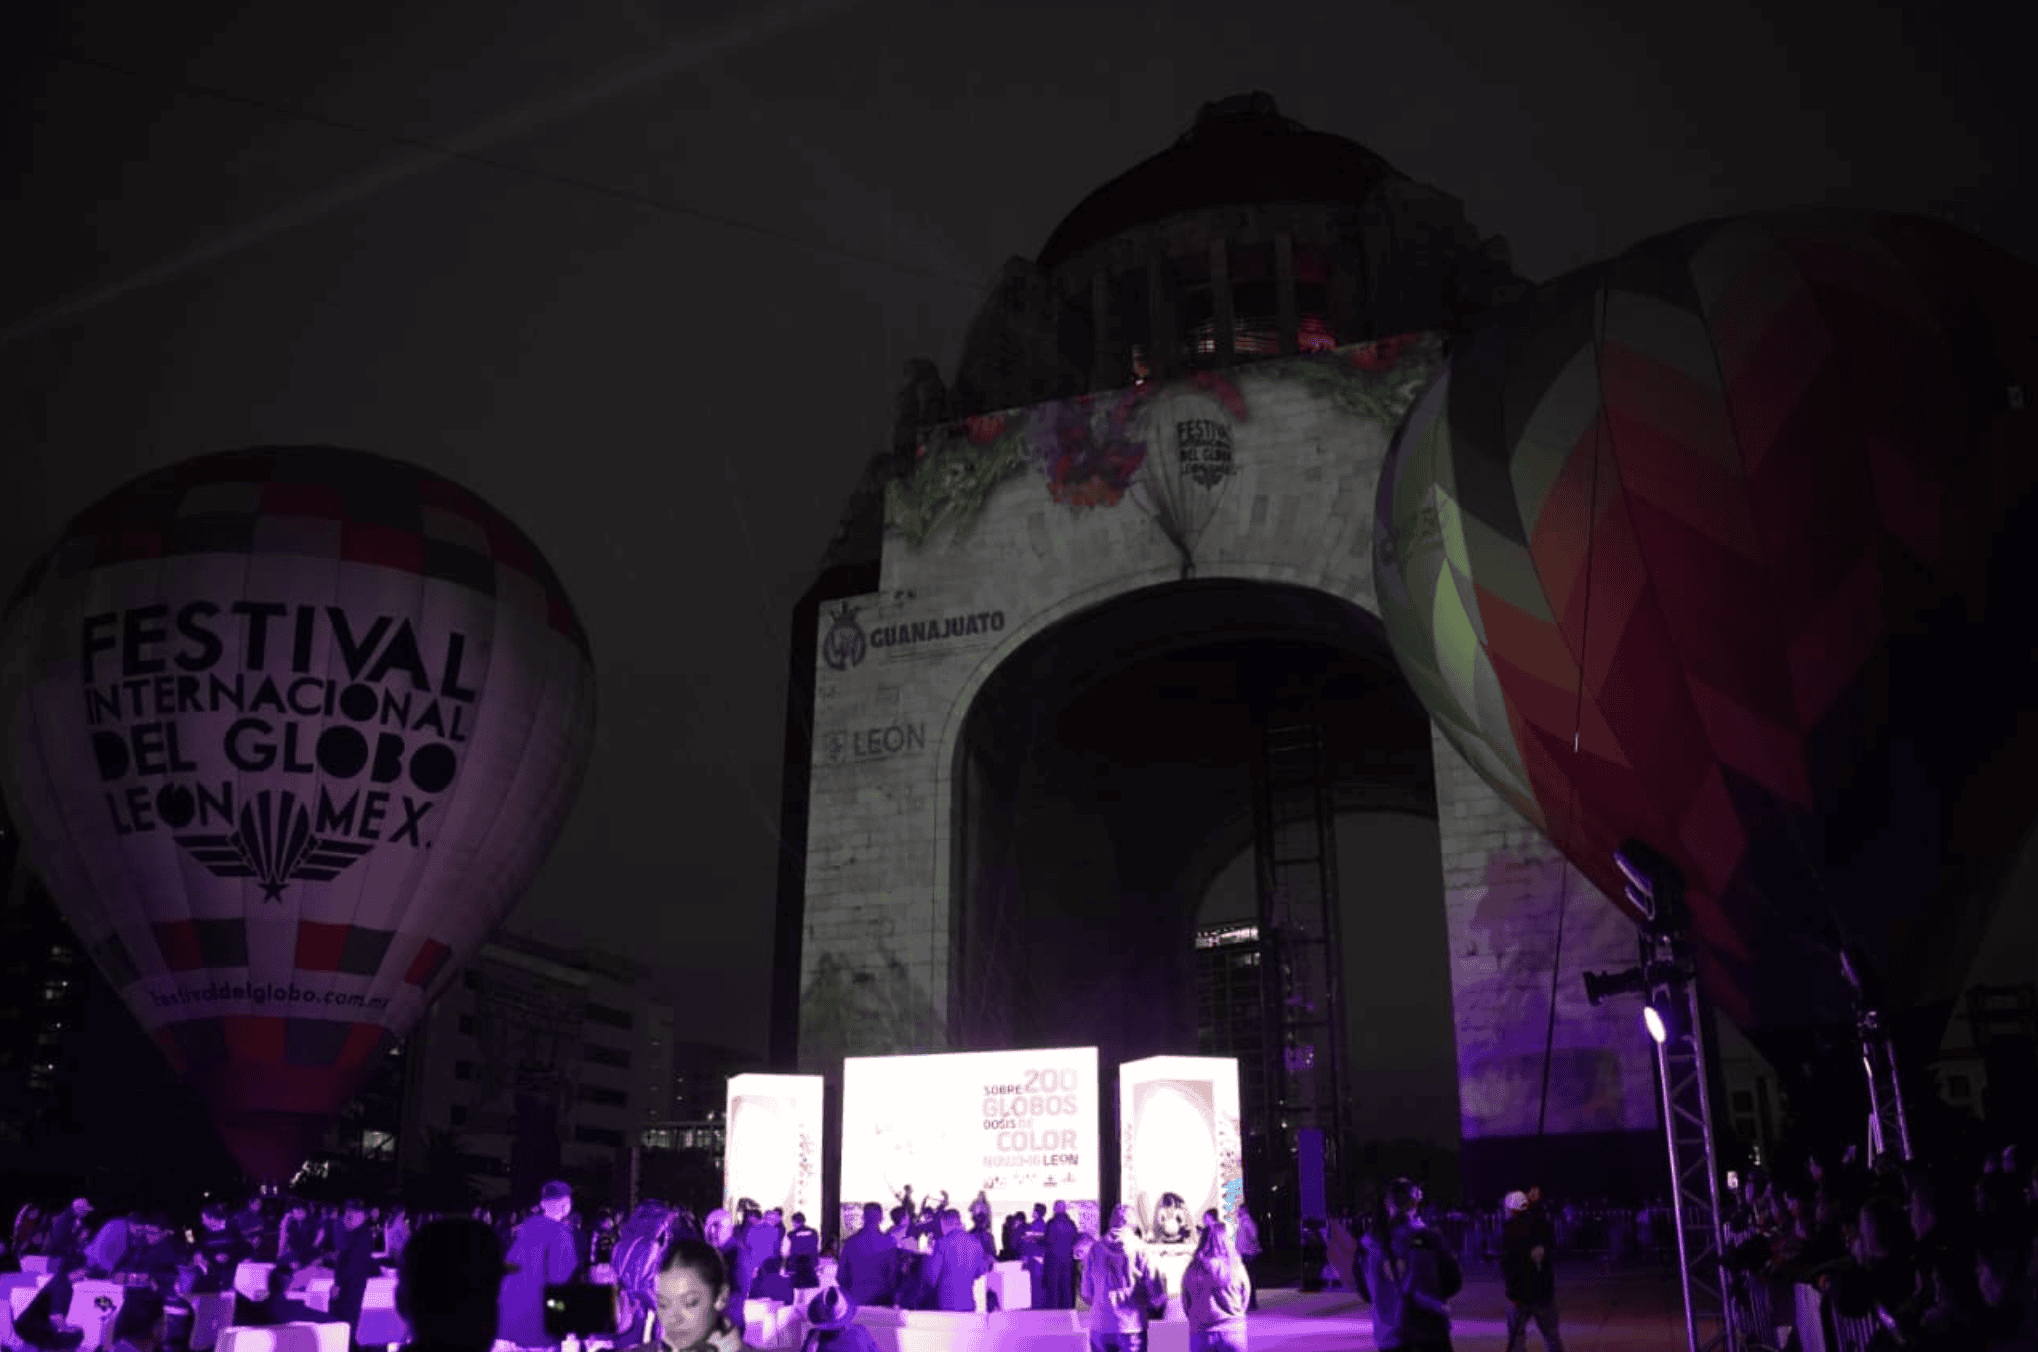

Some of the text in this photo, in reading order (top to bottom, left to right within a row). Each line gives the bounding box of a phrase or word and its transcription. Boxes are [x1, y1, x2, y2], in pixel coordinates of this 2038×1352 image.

[869, 610, 1006, 649] GUANAJUATO
[82, 601, 477, 702] FESTIVAL
[86, 673, 466, 742] INTERNACIONAL
[92, 716, 457, 794] DEL GLOBO
[983, 1067, 1079, 1096] SOBRE 200
[982, 1094, 1079, 1118] GLOBOS
[996, 1128, 1079, 1152] COLOR
